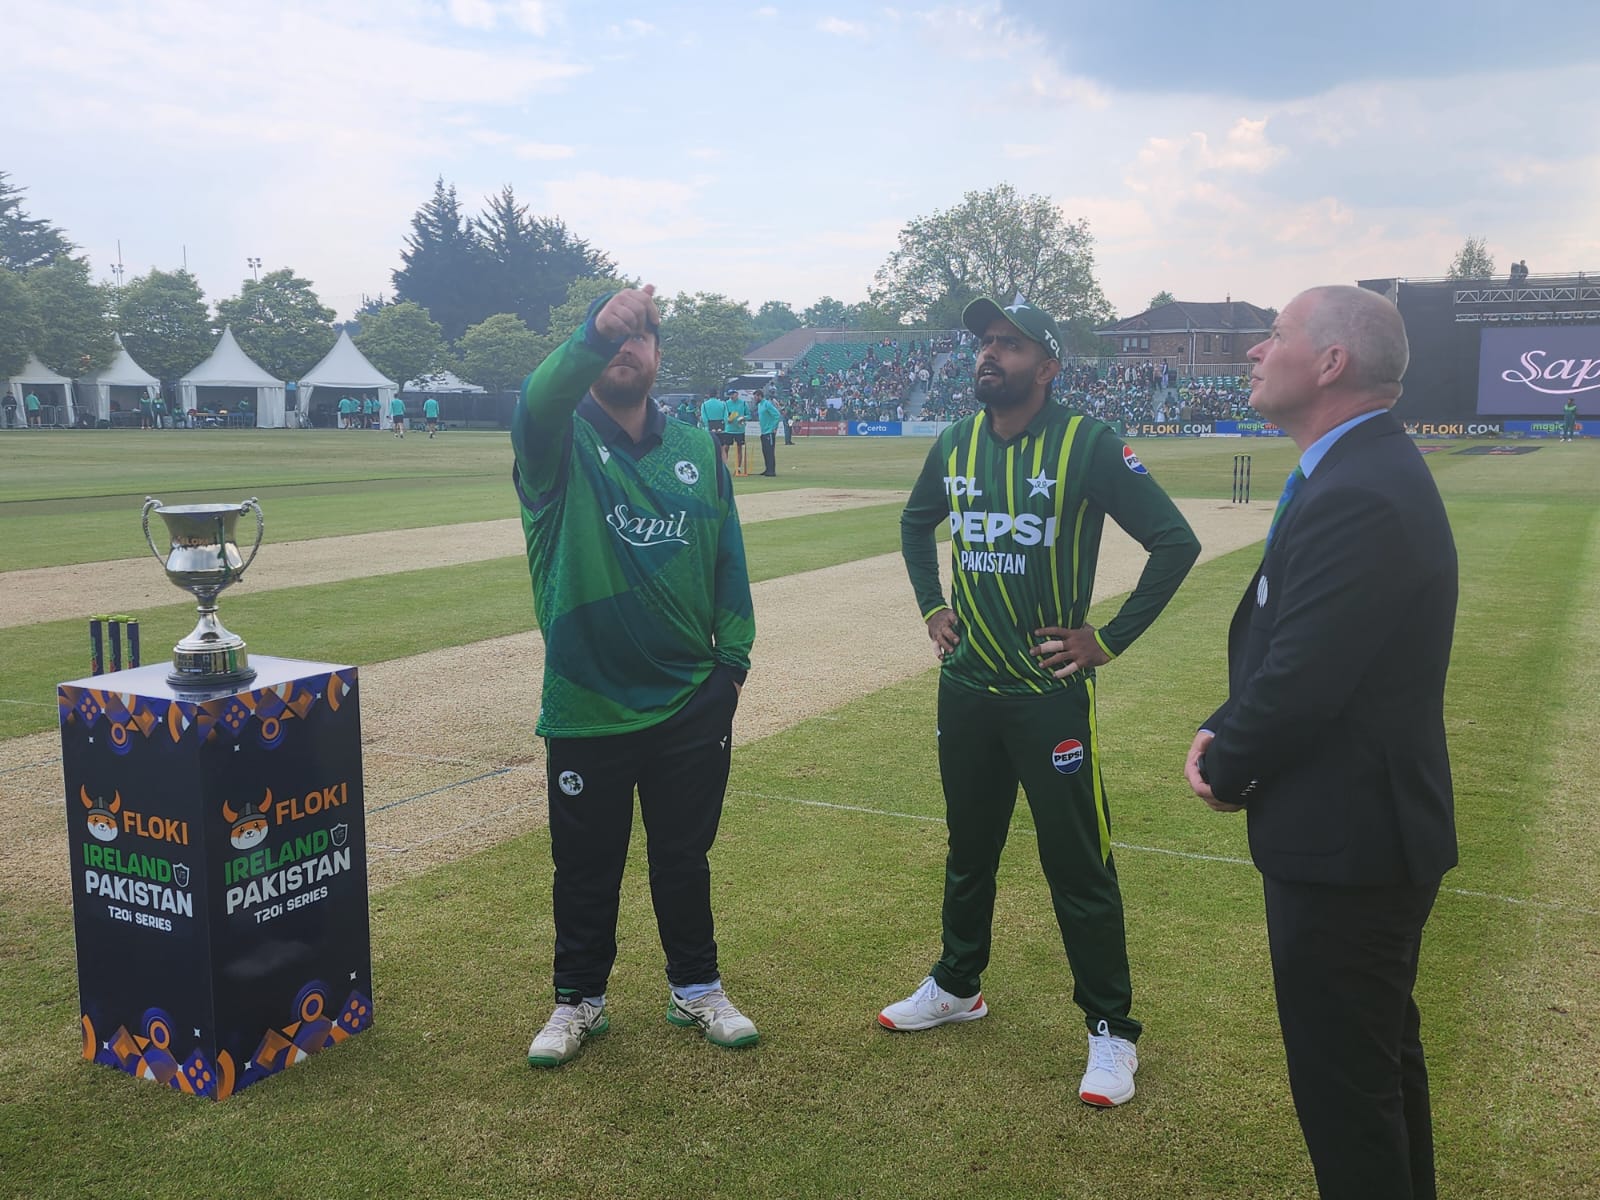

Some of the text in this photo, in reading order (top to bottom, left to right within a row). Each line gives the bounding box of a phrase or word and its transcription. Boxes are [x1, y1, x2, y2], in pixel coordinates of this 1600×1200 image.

[1044, 329, 1060, 359] TCL
[1142, 423, 1212, 434] FLOKI.COM
[1422, 423, 1500, 434] FLOKI.COM
[943, 476, 983, 497] TCL
[606, 504, 690, 546] Sapil
[949, 511, 1057, 547] PEPSI
[961, 550, 1026, 575] PAKISTAN
[1054, 750, 1082, 762] PEPSI
[275, 782, 349, 825] FLOKI
[122, 810, 189, 846] FLOKI
[82, 842, 172, 883] IRELAND
[224, 829, 329, 886] IRELAND
[84, 870, 193, 918] PAKISTAN
[226, 846, 351, 915] PAKISTAN
[107, 905, 172, 932] T20i SERIES
[253, 886, 329, 924] T20i SERIES
